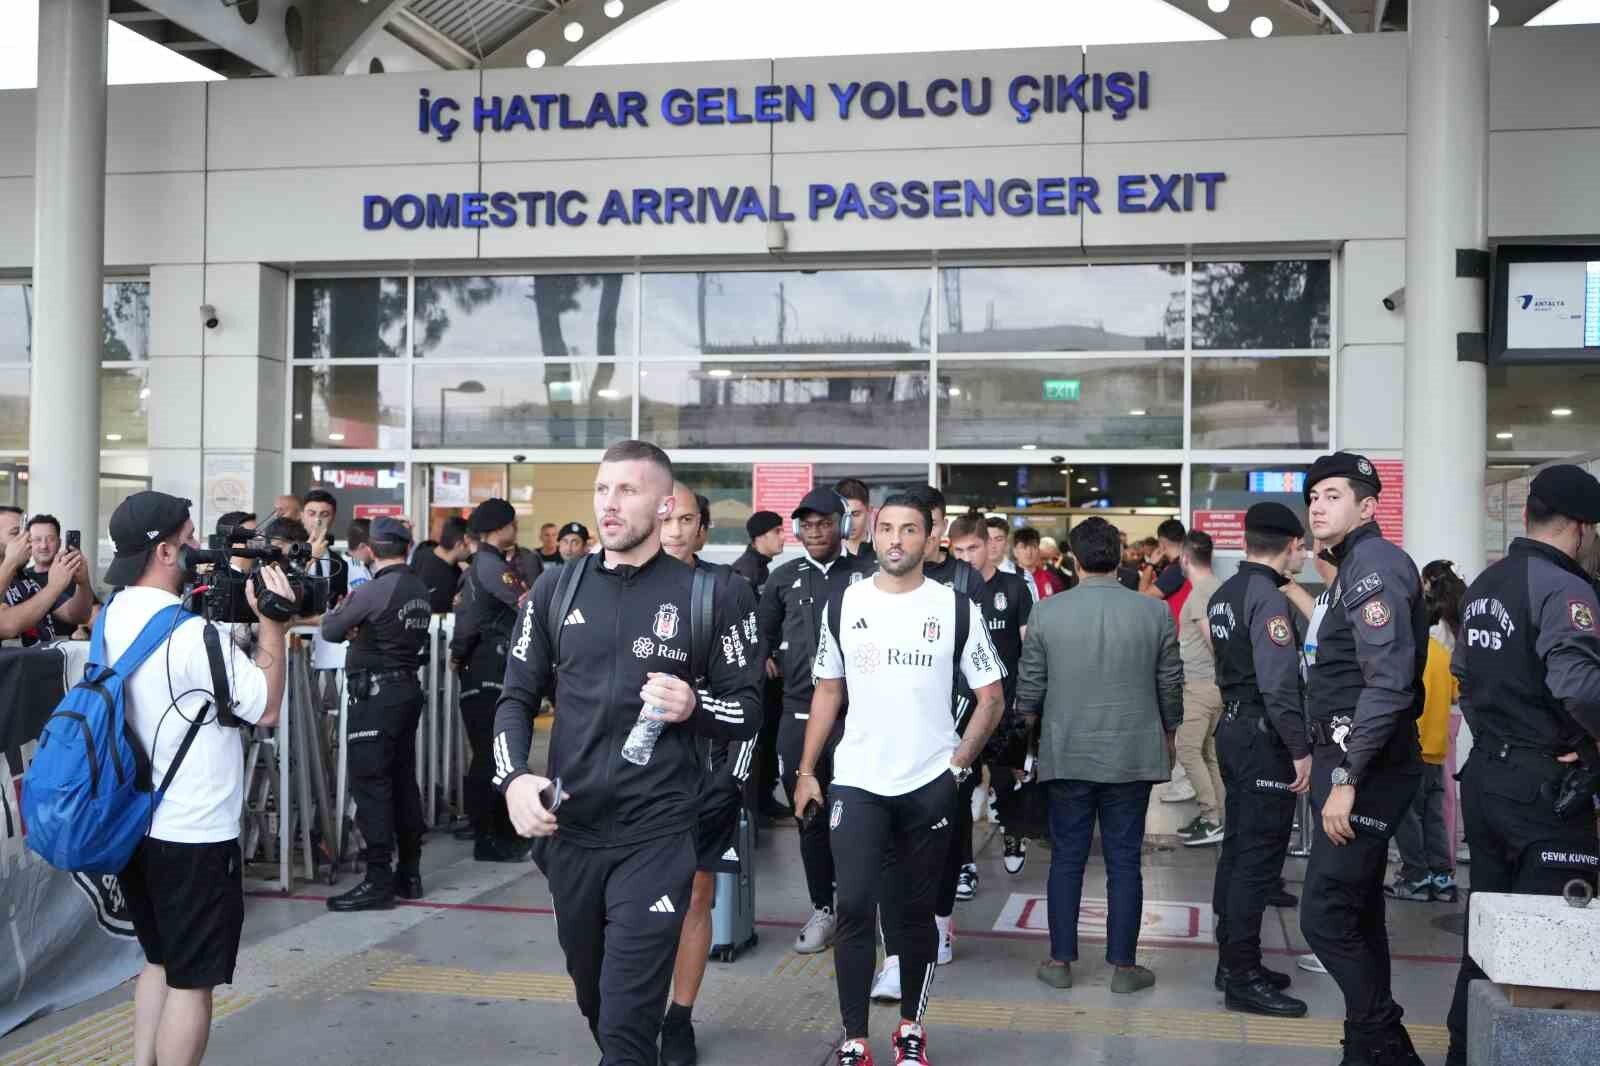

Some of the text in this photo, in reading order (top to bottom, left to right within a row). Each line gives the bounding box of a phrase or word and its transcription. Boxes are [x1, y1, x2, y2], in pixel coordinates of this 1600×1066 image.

[419, 70, 1150, 142] İÇ HATLAR GELEN YOLCU ÇIKIŞI
[364, 172, 1227, 230] DOMESTIC ARRIVAL PASSENGER EXIT
[1046, 382, 1079, 399] EXIT
[657, 644, 688, 663] Rain
[729, 624, 747, 668] NESİNE
[887, 648, 933, 667] Rain
